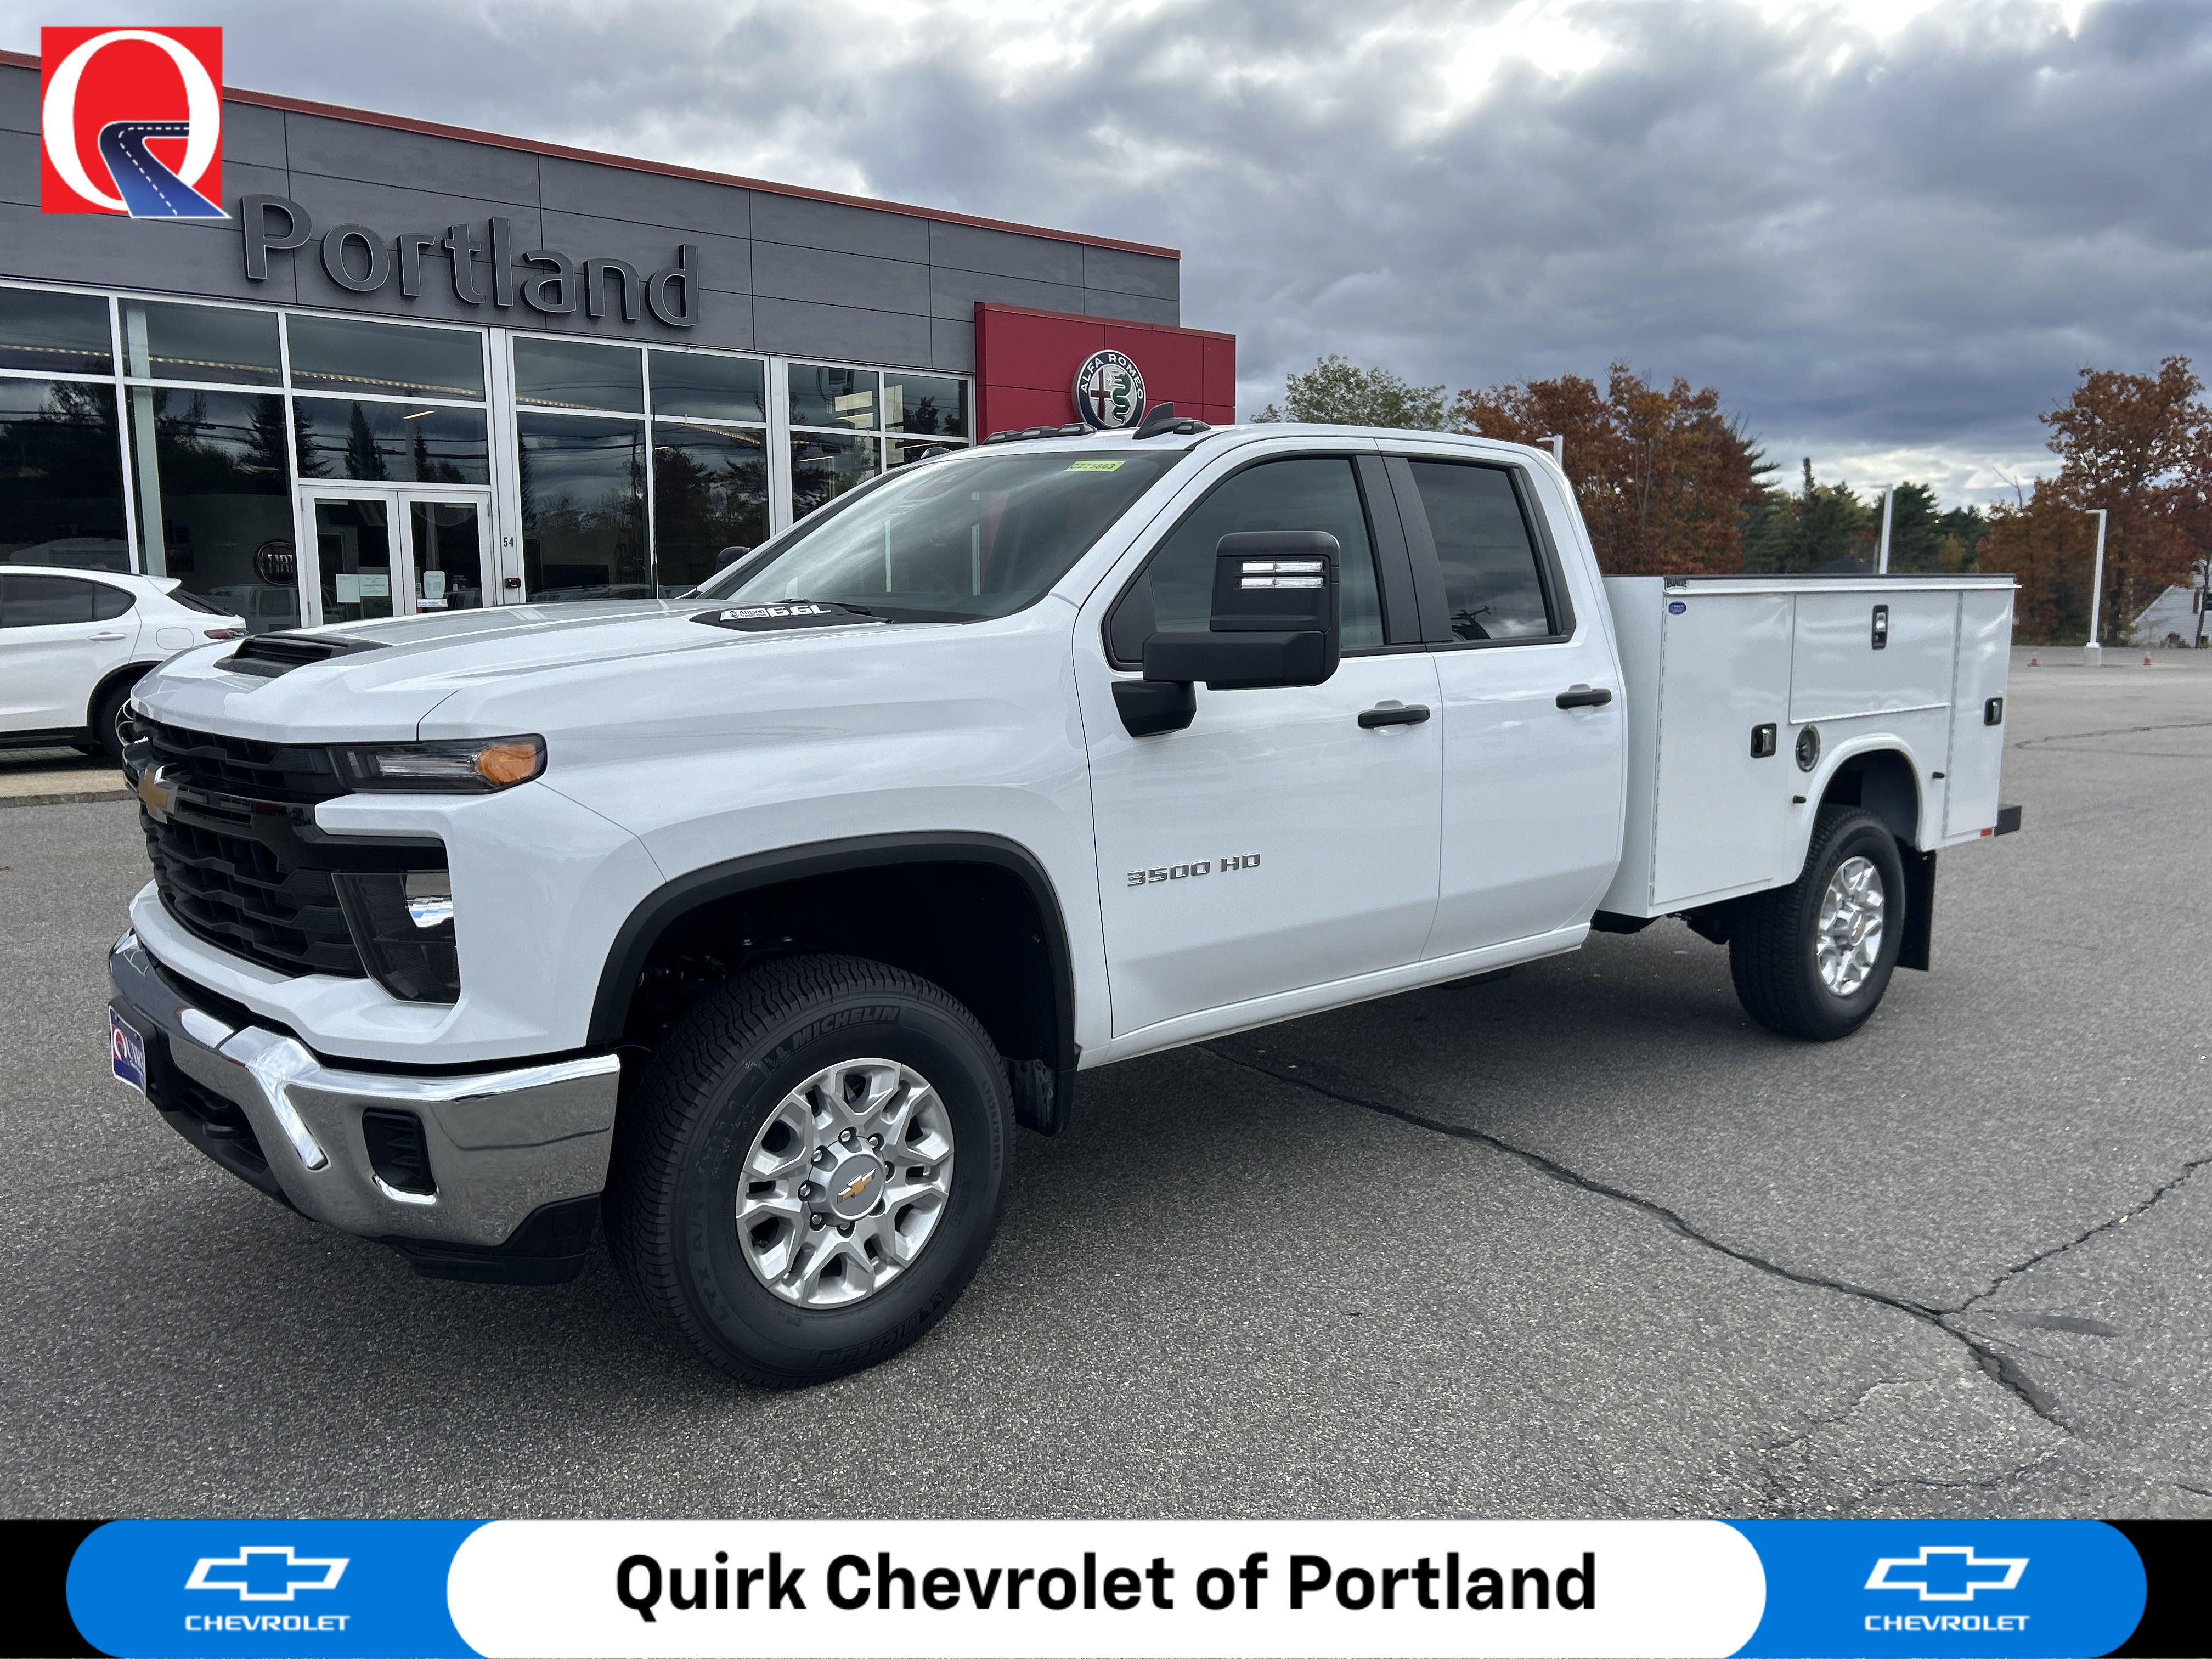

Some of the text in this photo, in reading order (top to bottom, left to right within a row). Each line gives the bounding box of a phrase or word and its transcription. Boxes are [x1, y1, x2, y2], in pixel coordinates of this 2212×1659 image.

[240, 194, 701, 328] Portland
[1080, 353, 1143, 399] ALFA ROMEO
[503, 537, 514, 548] 54
[1127, 853, 1261, 887] 3500 HD
[792, 1006, 900, 1051] MICHELIN
[814, 1310, 922, 1368] MICHELIN
